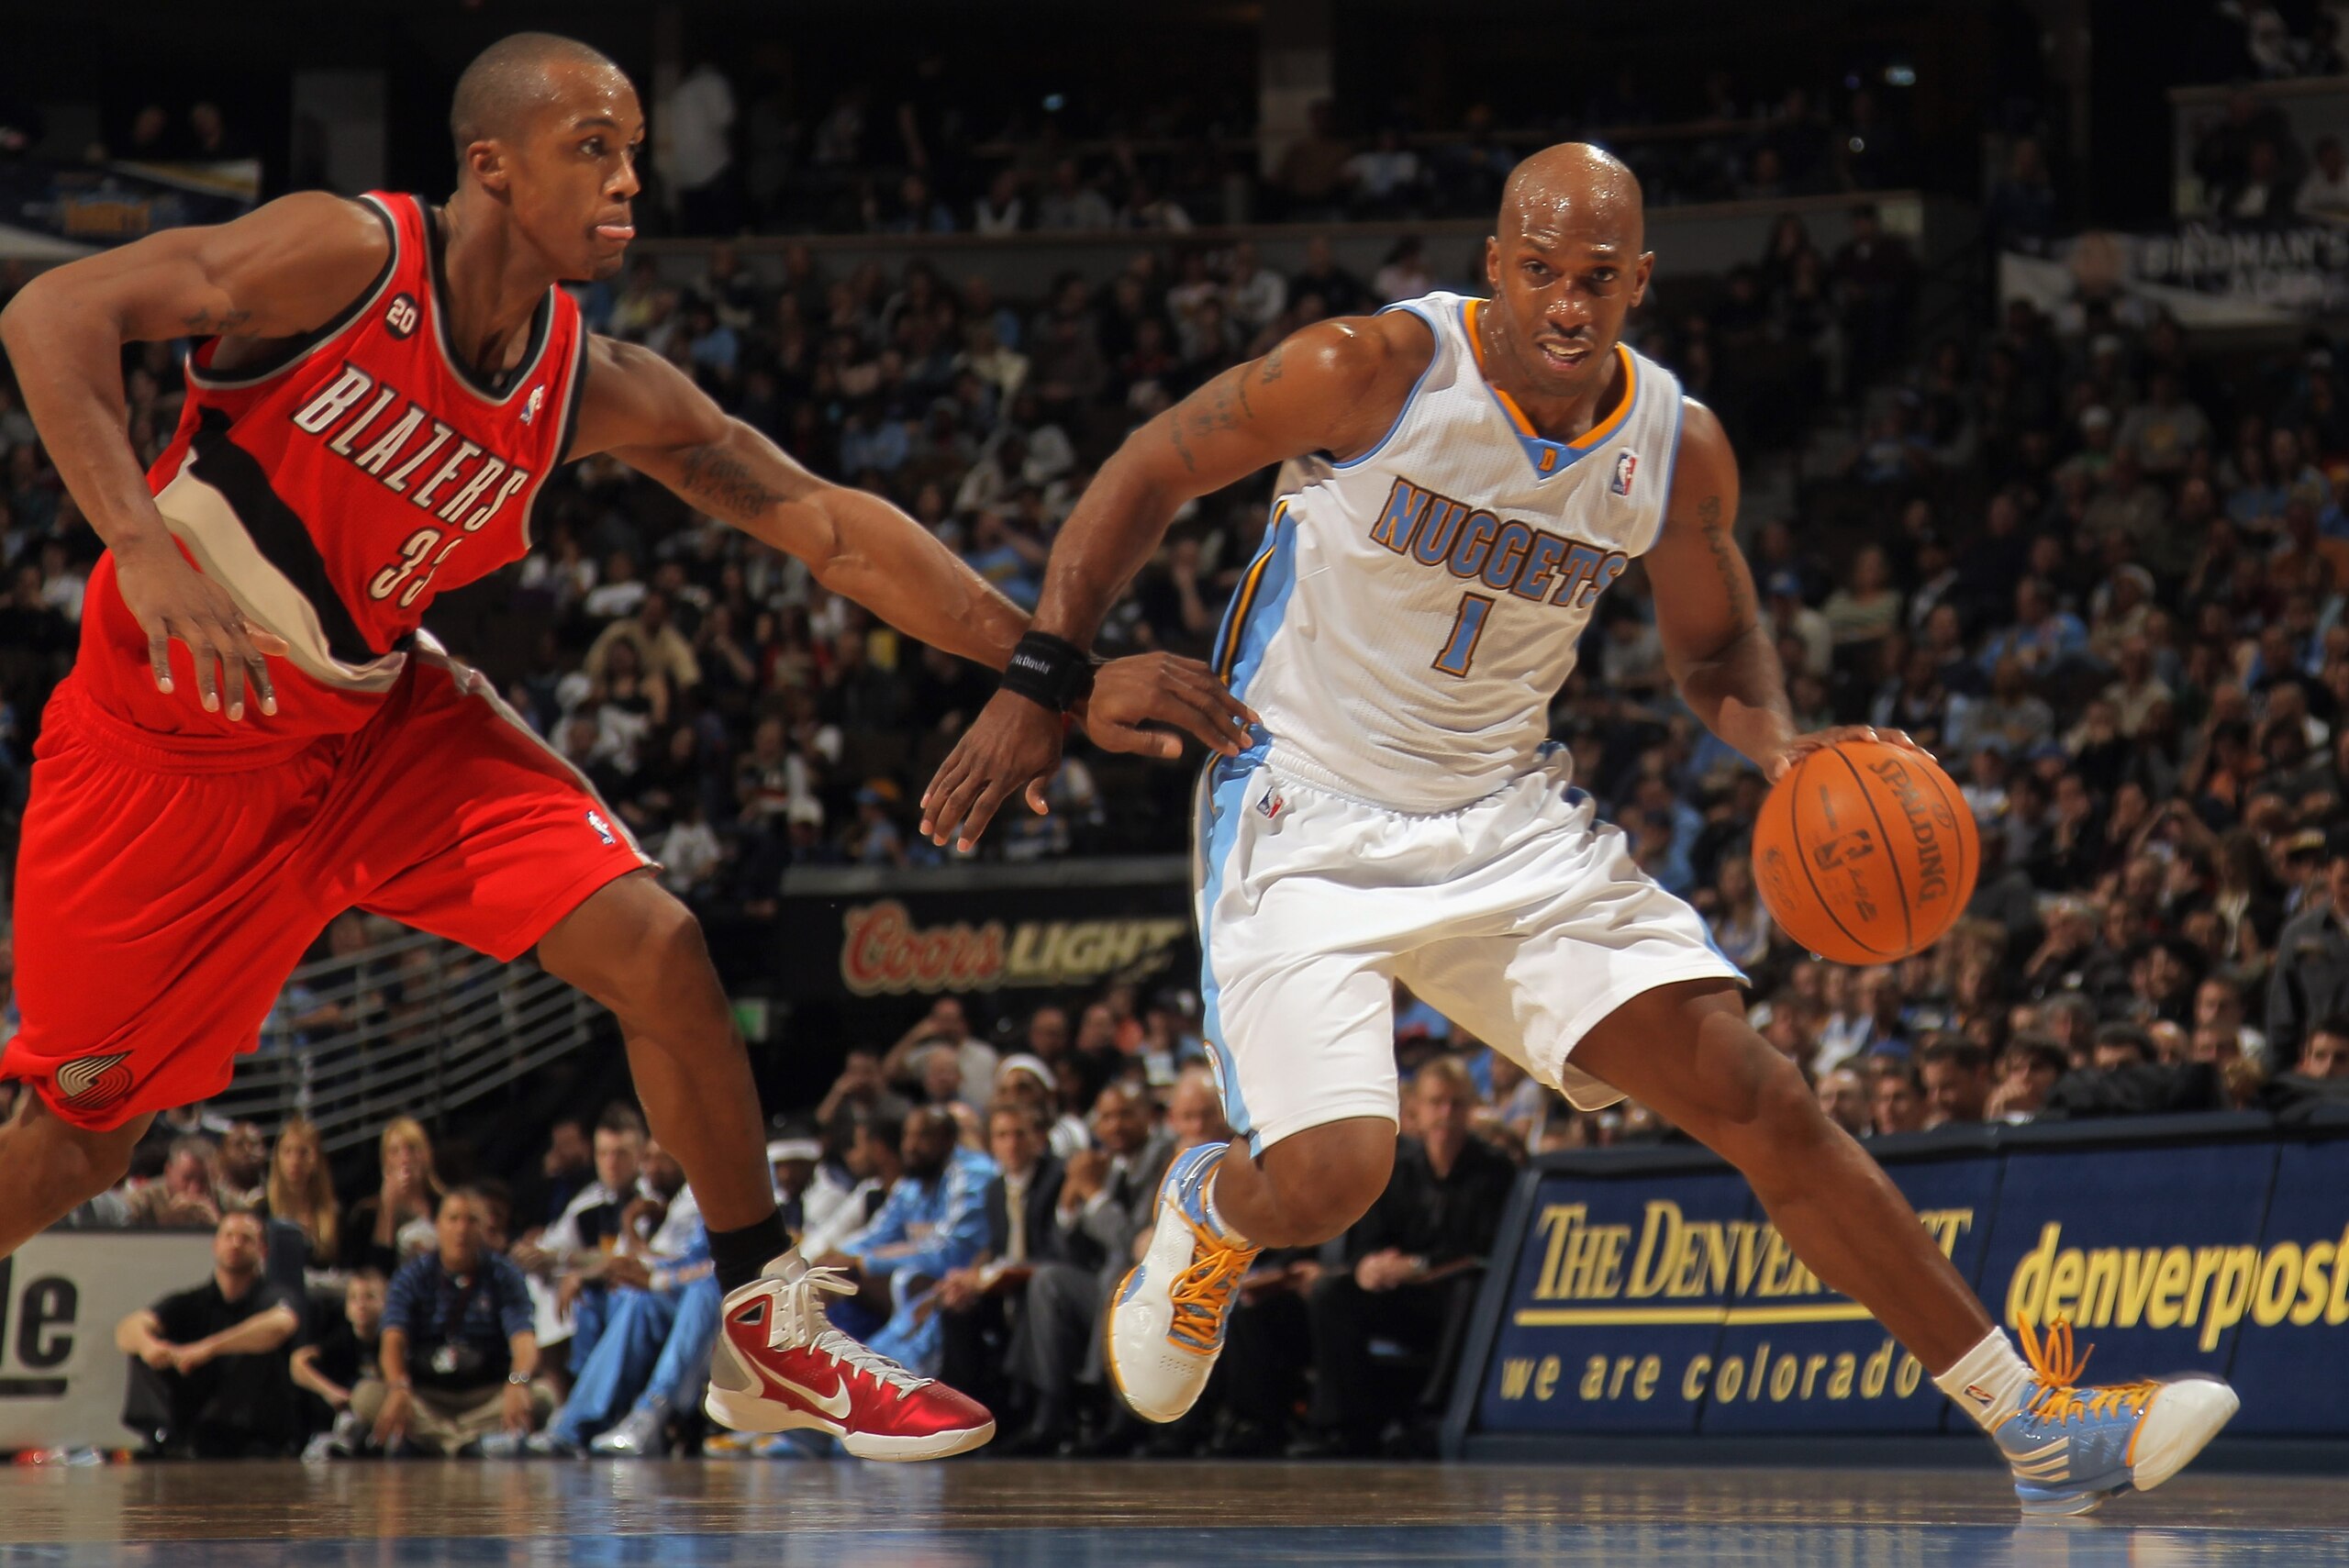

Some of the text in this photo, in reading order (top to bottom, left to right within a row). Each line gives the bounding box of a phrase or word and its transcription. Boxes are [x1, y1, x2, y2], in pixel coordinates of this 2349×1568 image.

[385, 296, 417, 334] 20
[290, 361, 529, 532] BLAZERS
[1368, 475, 1628, 608] NUGGETS
[1431, 591, 1497, 678] 1
[1866, 759, 1947, 909] SPALDING
[845, 898, 1186, 995] Coors LIGHT
[2004, 1220, 2349, 1352] denverpost
[1499, 1337, 1922, 1405] we are colorado
